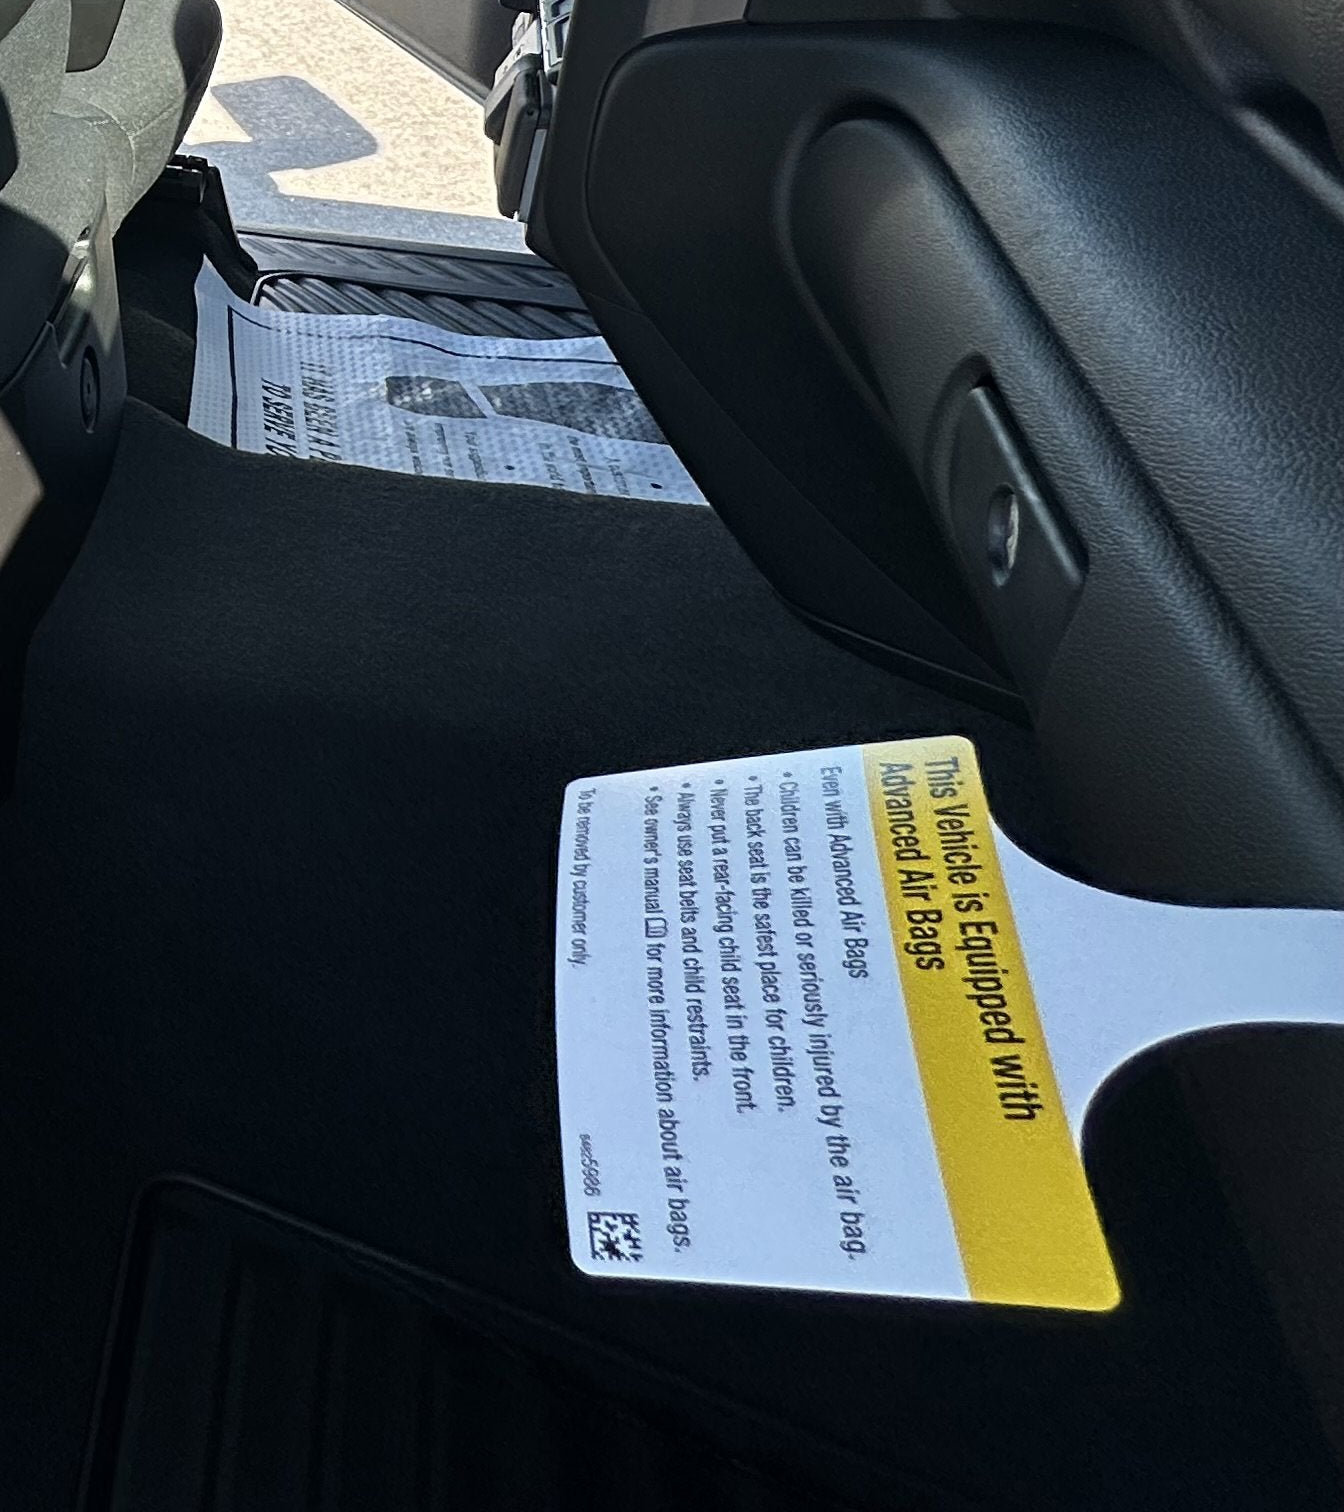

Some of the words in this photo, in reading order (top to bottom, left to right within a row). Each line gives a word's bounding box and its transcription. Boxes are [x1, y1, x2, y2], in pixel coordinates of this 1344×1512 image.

[261, 377, 292, 399] TO
[301, 376, 335, 403] HAS
[262, 396, 296, 441] SERVE
[303, 401, 339, 437] BEEN
[306, 434, 341, 448] A
[578, 788, 596, 800] To
[821, 766, 843, 796] Even
[925, 757, 963, 799] This
[577, 802, 593, 814] be
[644, 795, 663, 815] See
[710, 789, 728, 820] Never
[743, 784, 763, 806] The
[779, 782, 801, 833] Children
[673, 792, 696, 832] Always
[745, 809, 766, 838] back
[824, 799, 848, 829] with
[880, 763, 931, 861] Advanced
[574, 817, 592, 860] removed
[643, 819, 663, 864] owner's
[677, 835, 692, 856] use
[708, 825, 730, 843] put
[784, 838, 804, 861] can
[934, 804, 983, 885] Vehicle
[712, 848, 727, 856] a
[747, 842, 769, 868] seat
[570, 864, 591, 877] by
[678, 860, 697, 888] seat
[750, 872, 771, 883] is
[787, 866, 807, 883] be
[827, 834, 860, 905] Advanced
[897, 869, 937, 901] Air
[644, 867, 664, 914] manual
[712, 859, 738, 933] rear-facing
[751, 888, 773, 909] the
[952, 892, 990, 913] is
[571, 880, 590, 935] customer
[679, 891, 700, 923] belts
[790, 888, 814, 927] killed
[840, 910, 866, 932] Air
[681, 927, 703, 953] and
[754, 913, 779, 956] safest
[795, 932, 814, 948] or
[904, 909, 945, 970] Bags
[646, 943, 666, 961] for
[718, 937, 742, 972] child
[843, 938, 869, 978] Bags
[647, 967, 664, 1004] more
[683, 958, 706, 993] child
[754, 961, 783, 1003] place
[797, 953, 829, 1027] seriously
[955, 921, 1026, 1043] Equipped
[723, 977, 745, 1010] seat
[725, 1015, 747, 1029] in
[765, 1009, 788, 1030] for
[649, 1009, 676, 1102] information
[687, 999, 713, 1081] restraints.
[727, 1035, 750, 1061] the
[768, 1036, 797, 1113] children.
[806, 1034, 842, 1097] injured
[732, 1067, 758, 1113] front.
[990, 1054, 1044, 1121] with
[817, 1105, 844, 1128] by
[657, 1109, 683, 1160] about
[825, 1135, 851, 1167] the
[663, 1167, 688, 1192] air
[832, 1175, 860, 1204] air
[667, 1198, 692, 1253] bags.
[839, 1212, 867, 1260] bag.
